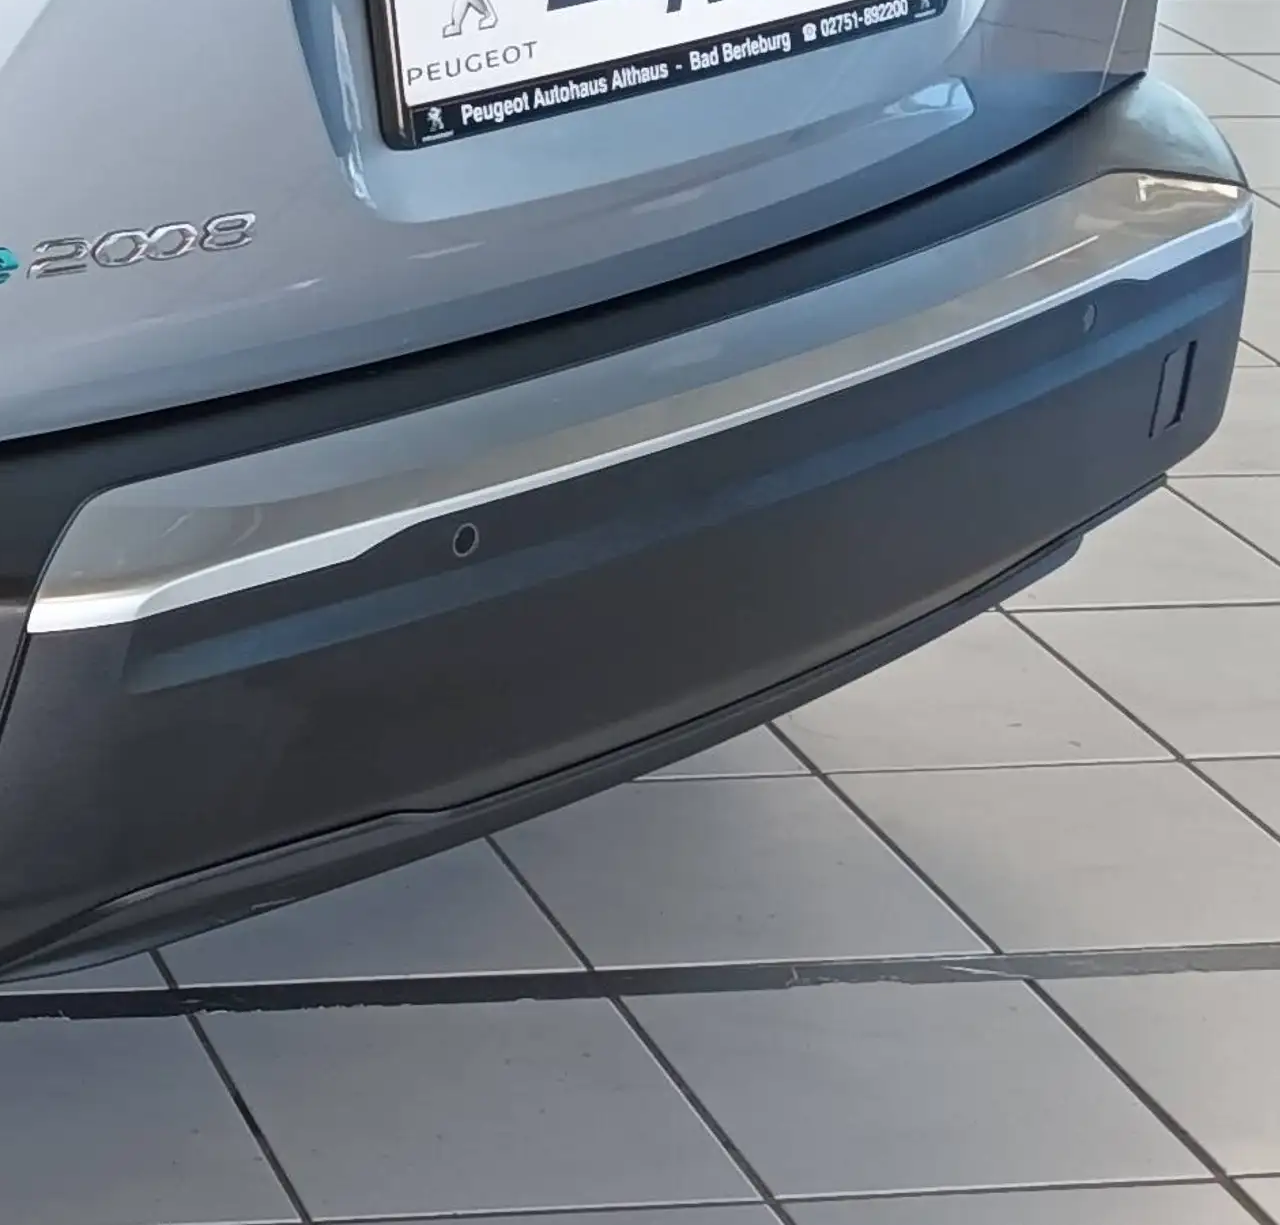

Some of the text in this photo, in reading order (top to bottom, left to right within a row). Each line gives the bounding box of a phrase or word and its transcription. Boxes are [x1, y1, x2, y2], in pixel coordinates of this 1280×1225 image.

[406, 40, 538, 86] PEUGEOT
[460, 91, 531, 126] Peugeot
[533, 75, 608, 109] Autohaus
[611, 61, 669, 91] Althaus
[689, 42, 720, 71] Bad
[721, 31, 792, 62] Berleburg
[26, 210, 256, 279] 2008
